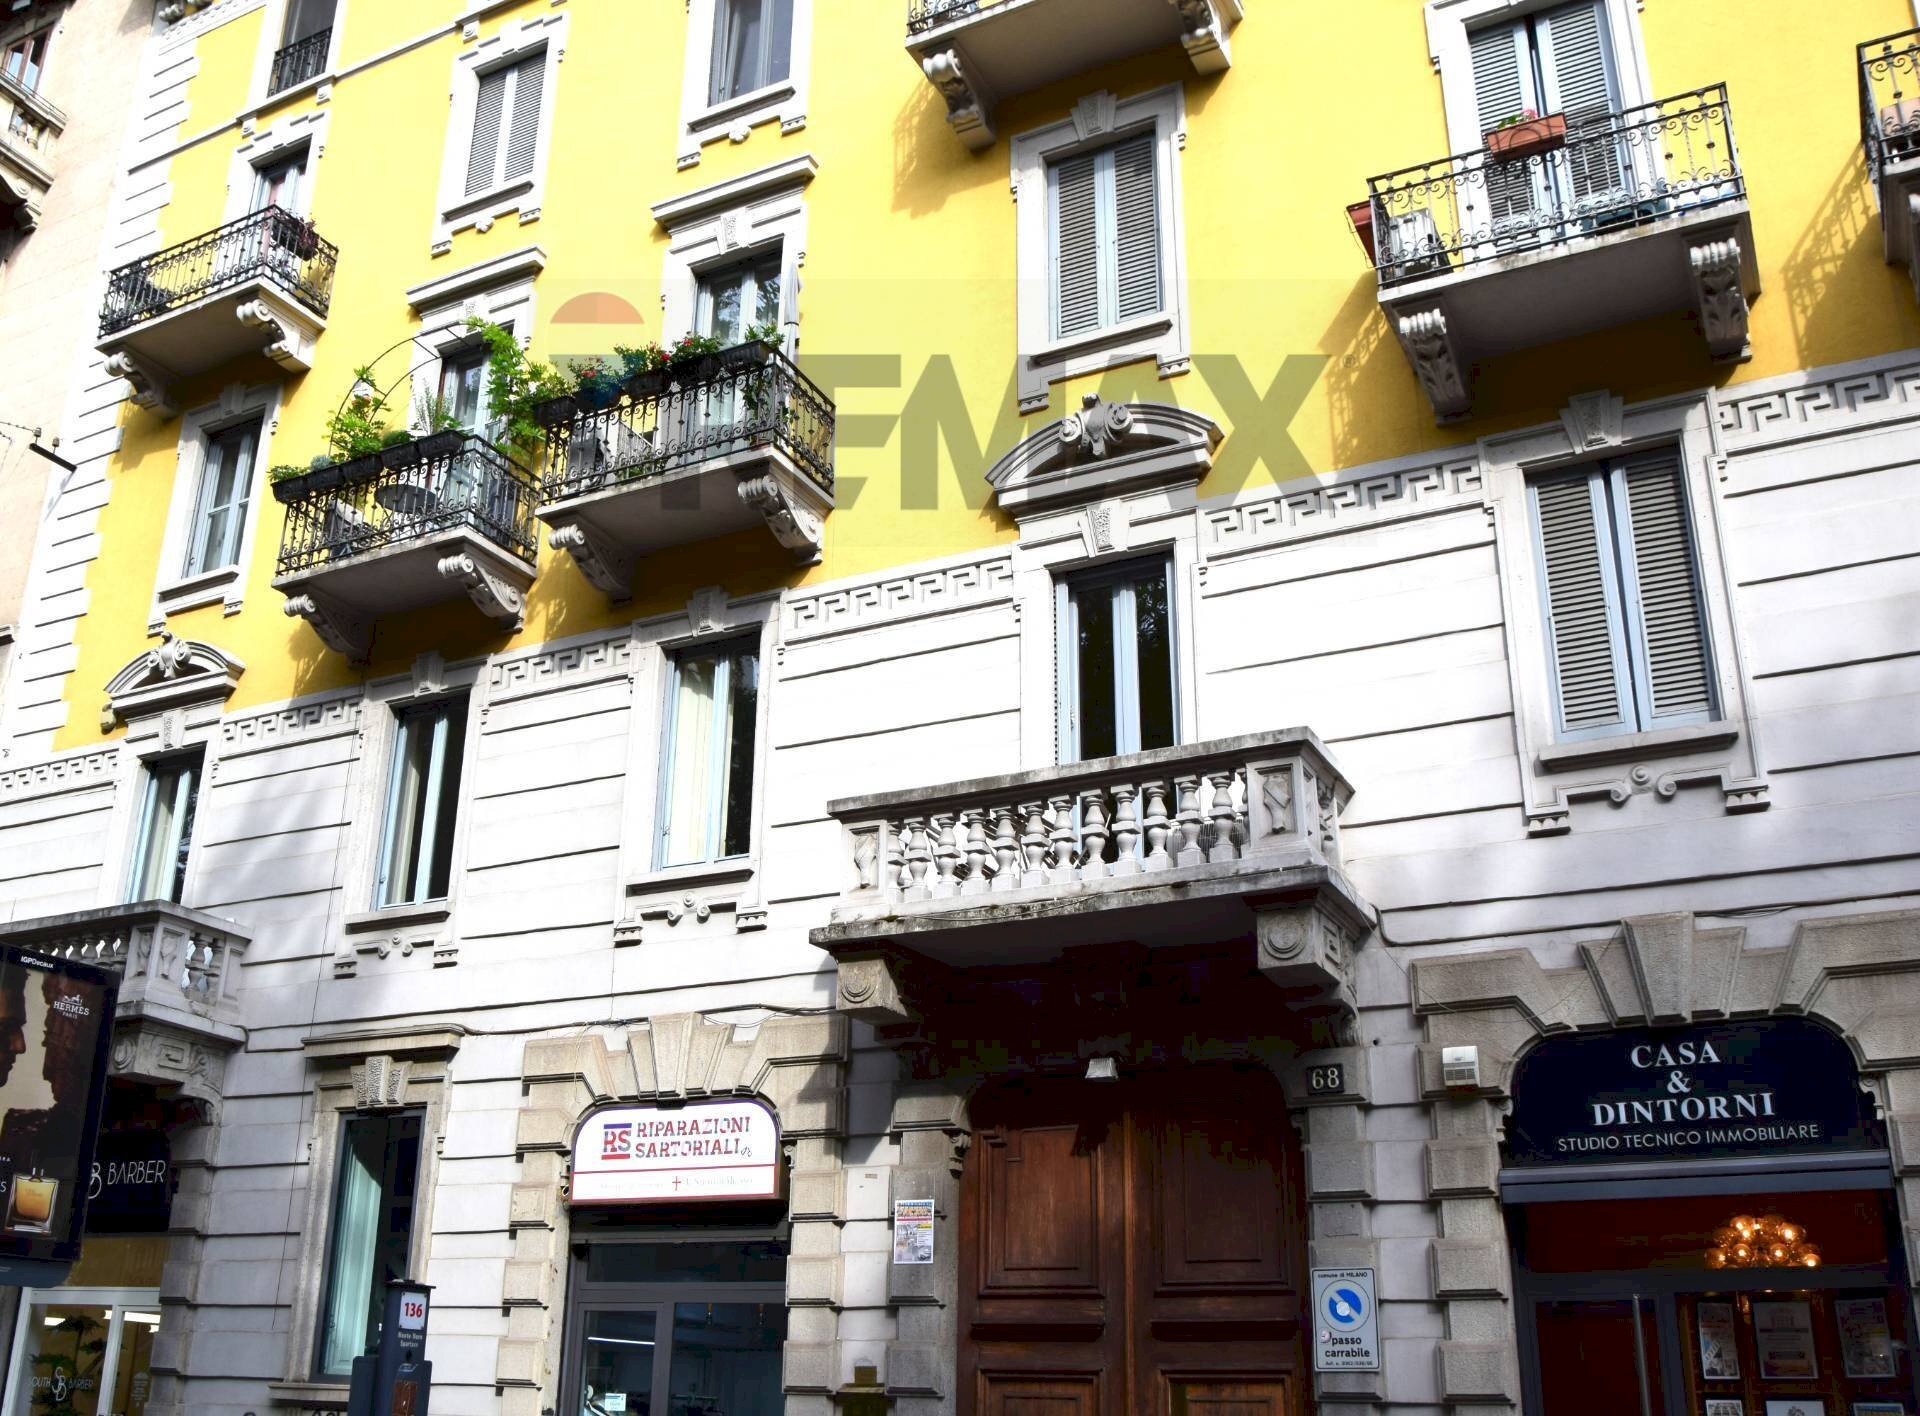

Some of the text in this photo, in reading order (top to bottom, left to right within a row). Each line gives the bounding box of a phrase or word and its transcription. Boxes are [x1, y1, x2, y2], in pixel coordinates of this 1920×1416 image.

[1630, 1040, 1720, 1069] CASA
[1312, 1067, 1340, 1089] 68
[1667, 1070, 1692, 1094] &
[1592, 1092, 1776, 1126] DINTORNI
[637, 1116, 751, 1138] RIPARAZIONI
[1558, 1124, 1820, 1152] STUDIO TECNICO IMMOBILIARE
[602, 1129, 632, 1153] RS
[635, 1138, 741, 1158] SARTORIALI
[107, 1160, 166, 1185] BARBER
[404, 1302, 423, 1318] 136
[1324, 1347, 1370, 1358] carrabile
[1331, 1336, 1362, 1346] passo
